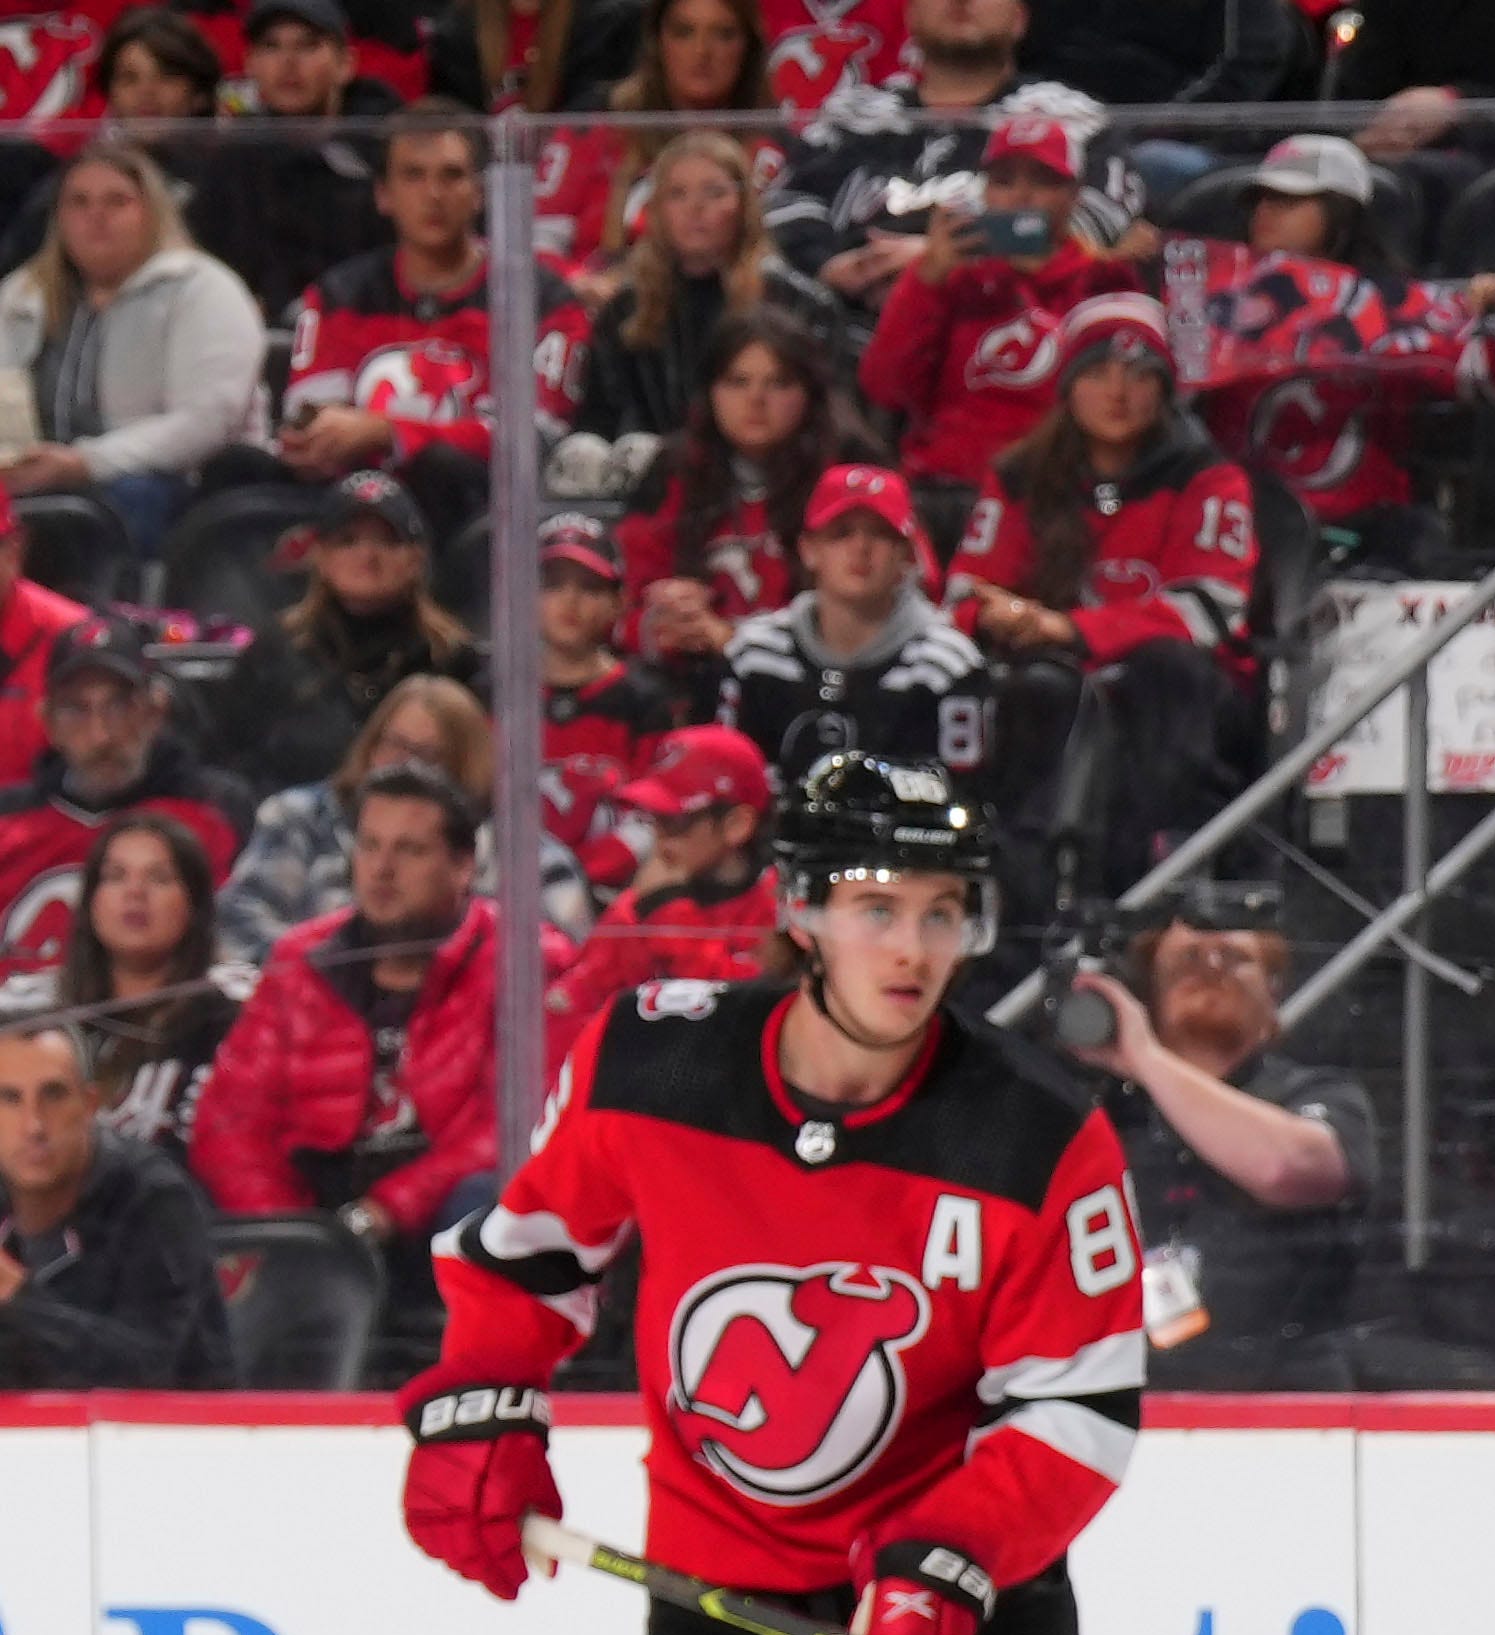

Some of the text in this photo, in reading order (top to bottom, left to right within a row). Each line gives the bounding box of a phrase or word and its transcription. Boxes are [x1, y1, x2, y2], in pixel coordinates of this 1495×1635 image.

[1194, 495, 1254, 557] 13
[922, 1193, 983, 1292] A
[1067, 1168, 1144, 1298] 8
